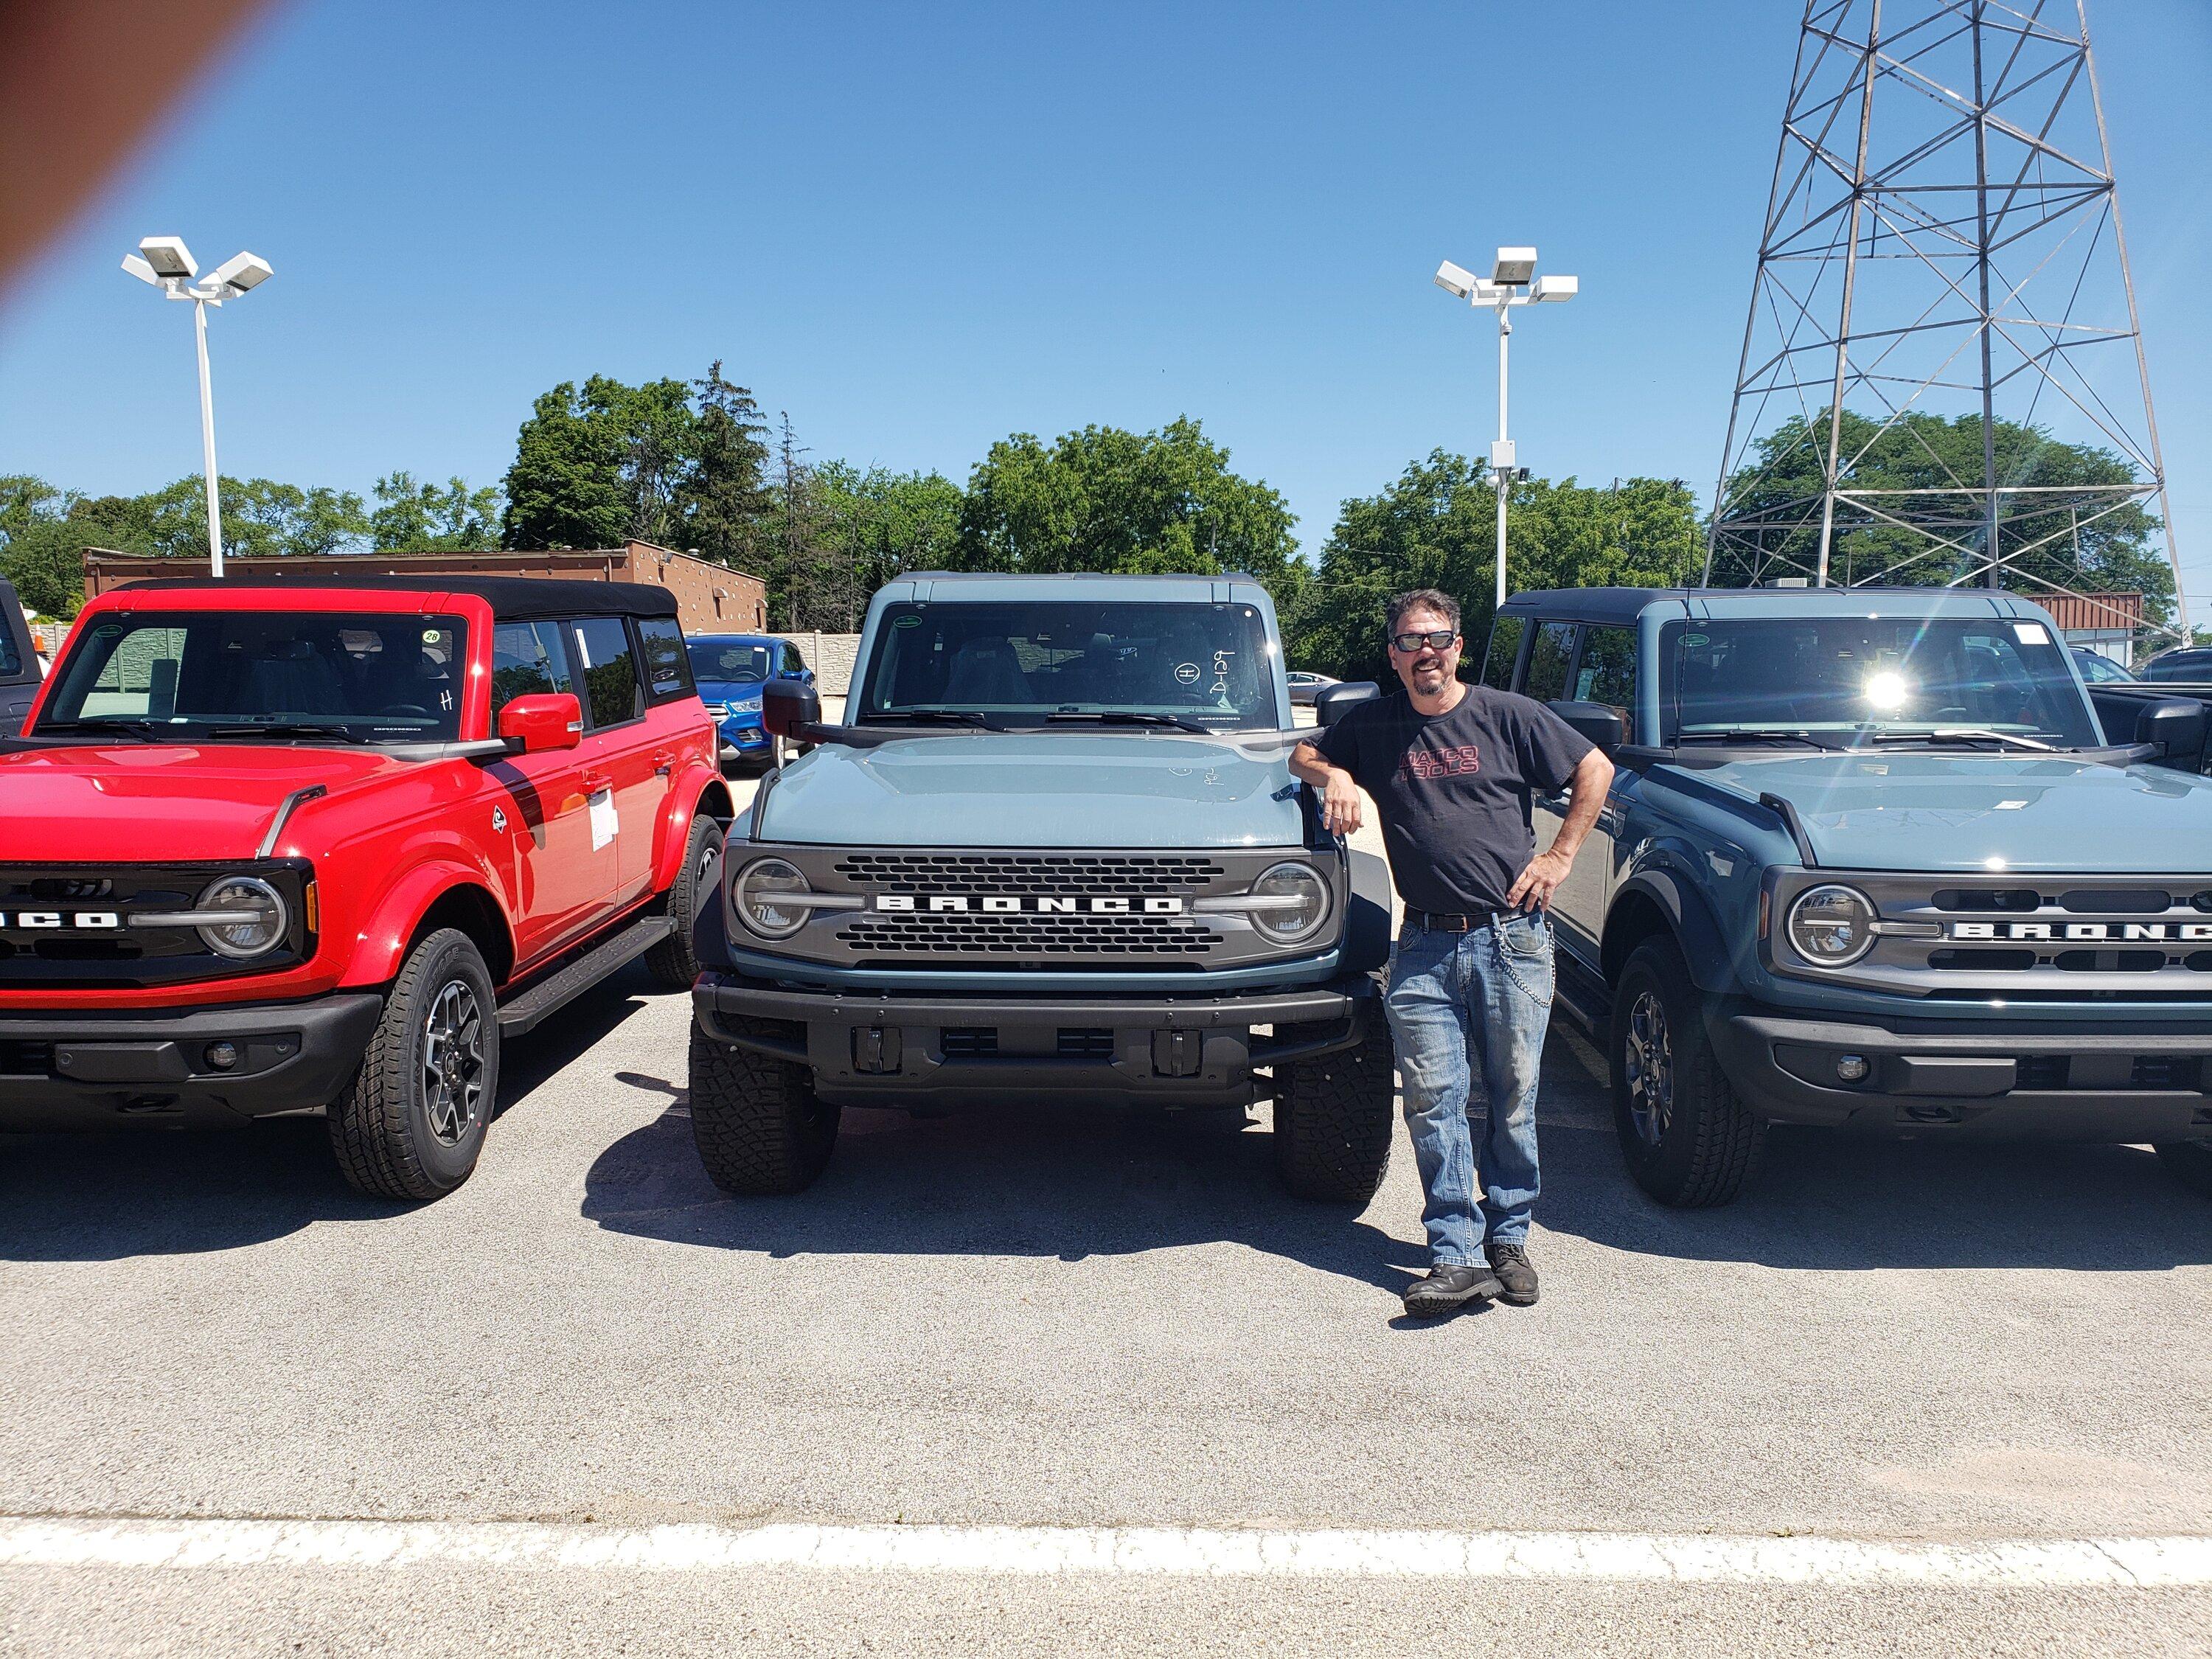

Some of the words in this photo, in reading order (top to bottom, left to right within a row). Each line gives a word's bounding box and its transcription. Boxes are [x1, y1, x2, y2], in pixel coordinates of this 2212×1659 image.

[425, 632, 438, 641] 28
[1399, 745, 1478, 768] MATCO
[1399, 759, 1479, 782] TOOLS
[876, 895, 1183, 913] BRONCO
[0, 912, 118, 928] CO
